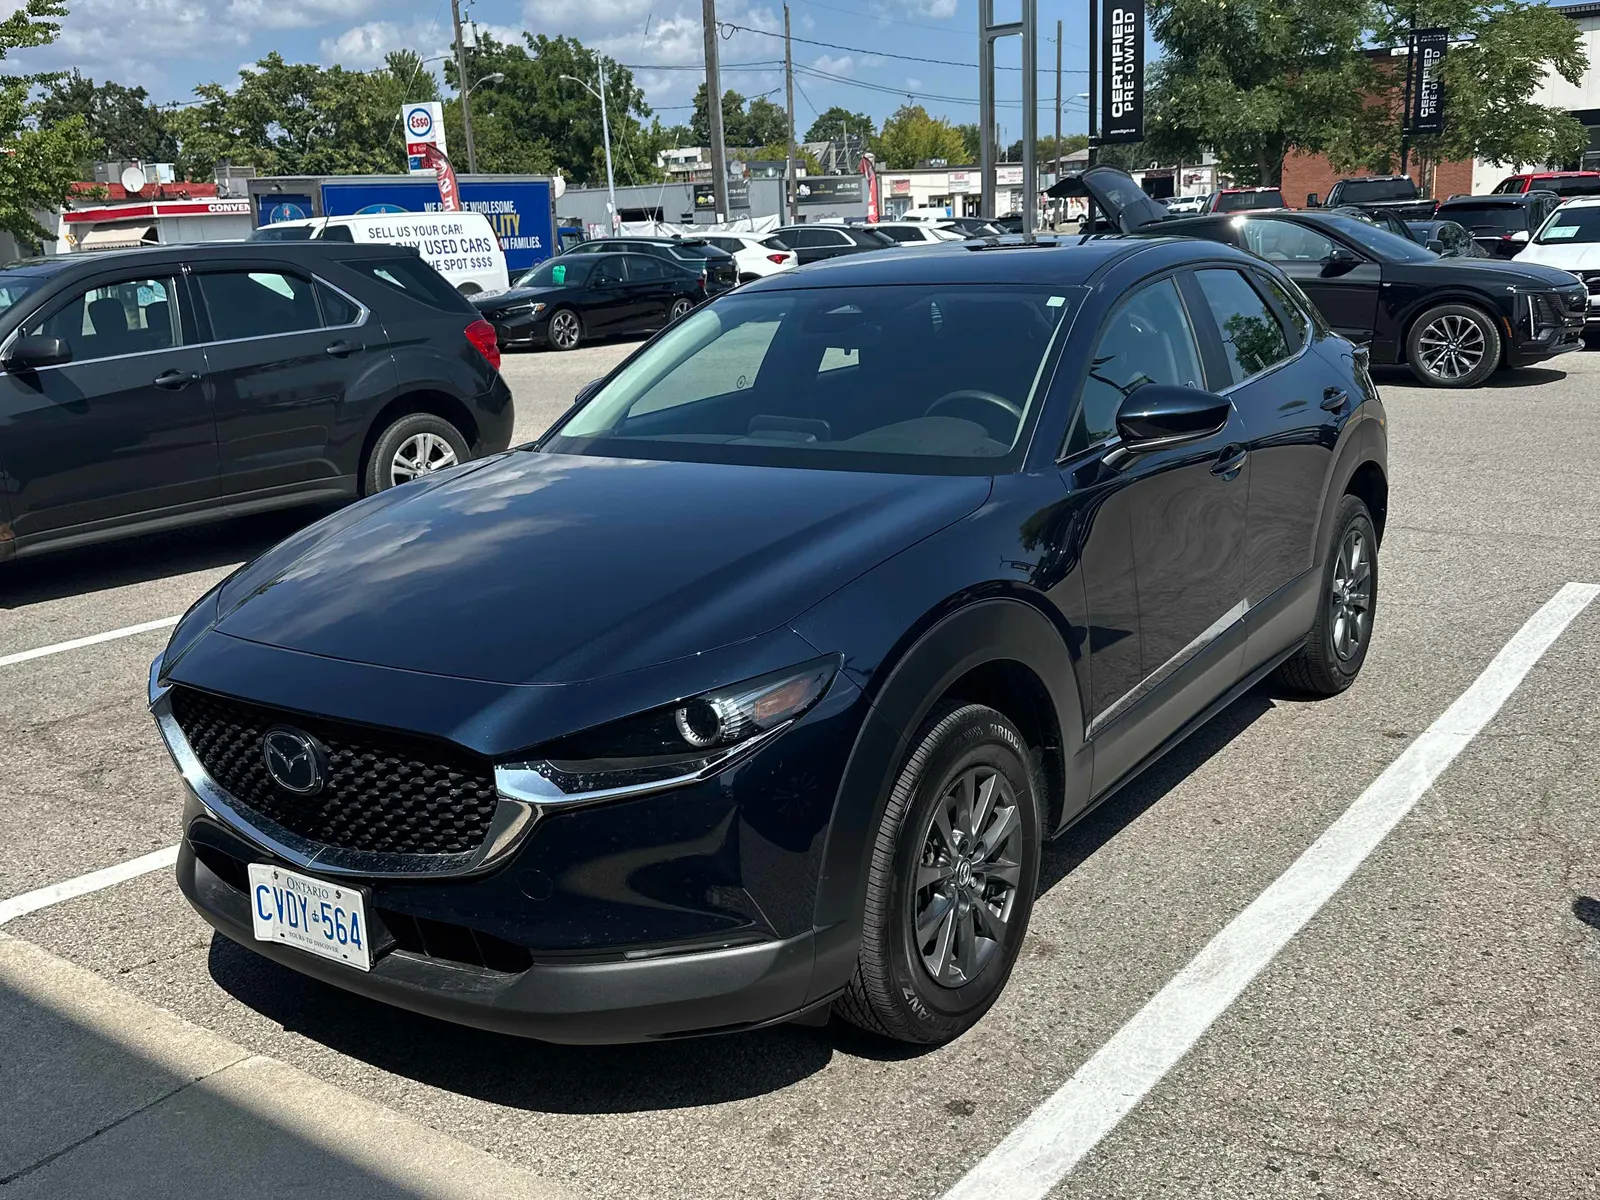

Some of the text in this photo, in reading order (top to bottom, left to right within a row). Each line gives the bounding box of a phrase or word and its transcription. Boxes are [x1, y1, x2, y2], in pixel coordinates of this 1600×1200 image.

[1111, 8, 1124, 118] CERTIFIED
[1124, 12, 1135, 112] PRE-OWNED
[1420, 48, 1433, 118] CERTIFIED
[1429, 50, 1441, 114] PRE-OED
[411, 116, 429, 129] Esso
[424, 202, 437, 212] WE
[469, 200, 517, 214] WHOLESOME,
[368, 223, 464, 239] SELL US YOUR CAR!
[424, 239, 458, 255] USED
[460, 237, 492, 253] CARS
[510, 236, 542, 250] FAMILIES.
[427, 256, 493, 272] HE SPOT $$$$
[286, 876, 329, 900] ONTARIO
[256, 884, 362, 951] CVDY 564
[288, 931, 305, 943] YOURS
[313, 939, 340, 954] DISCOVER
